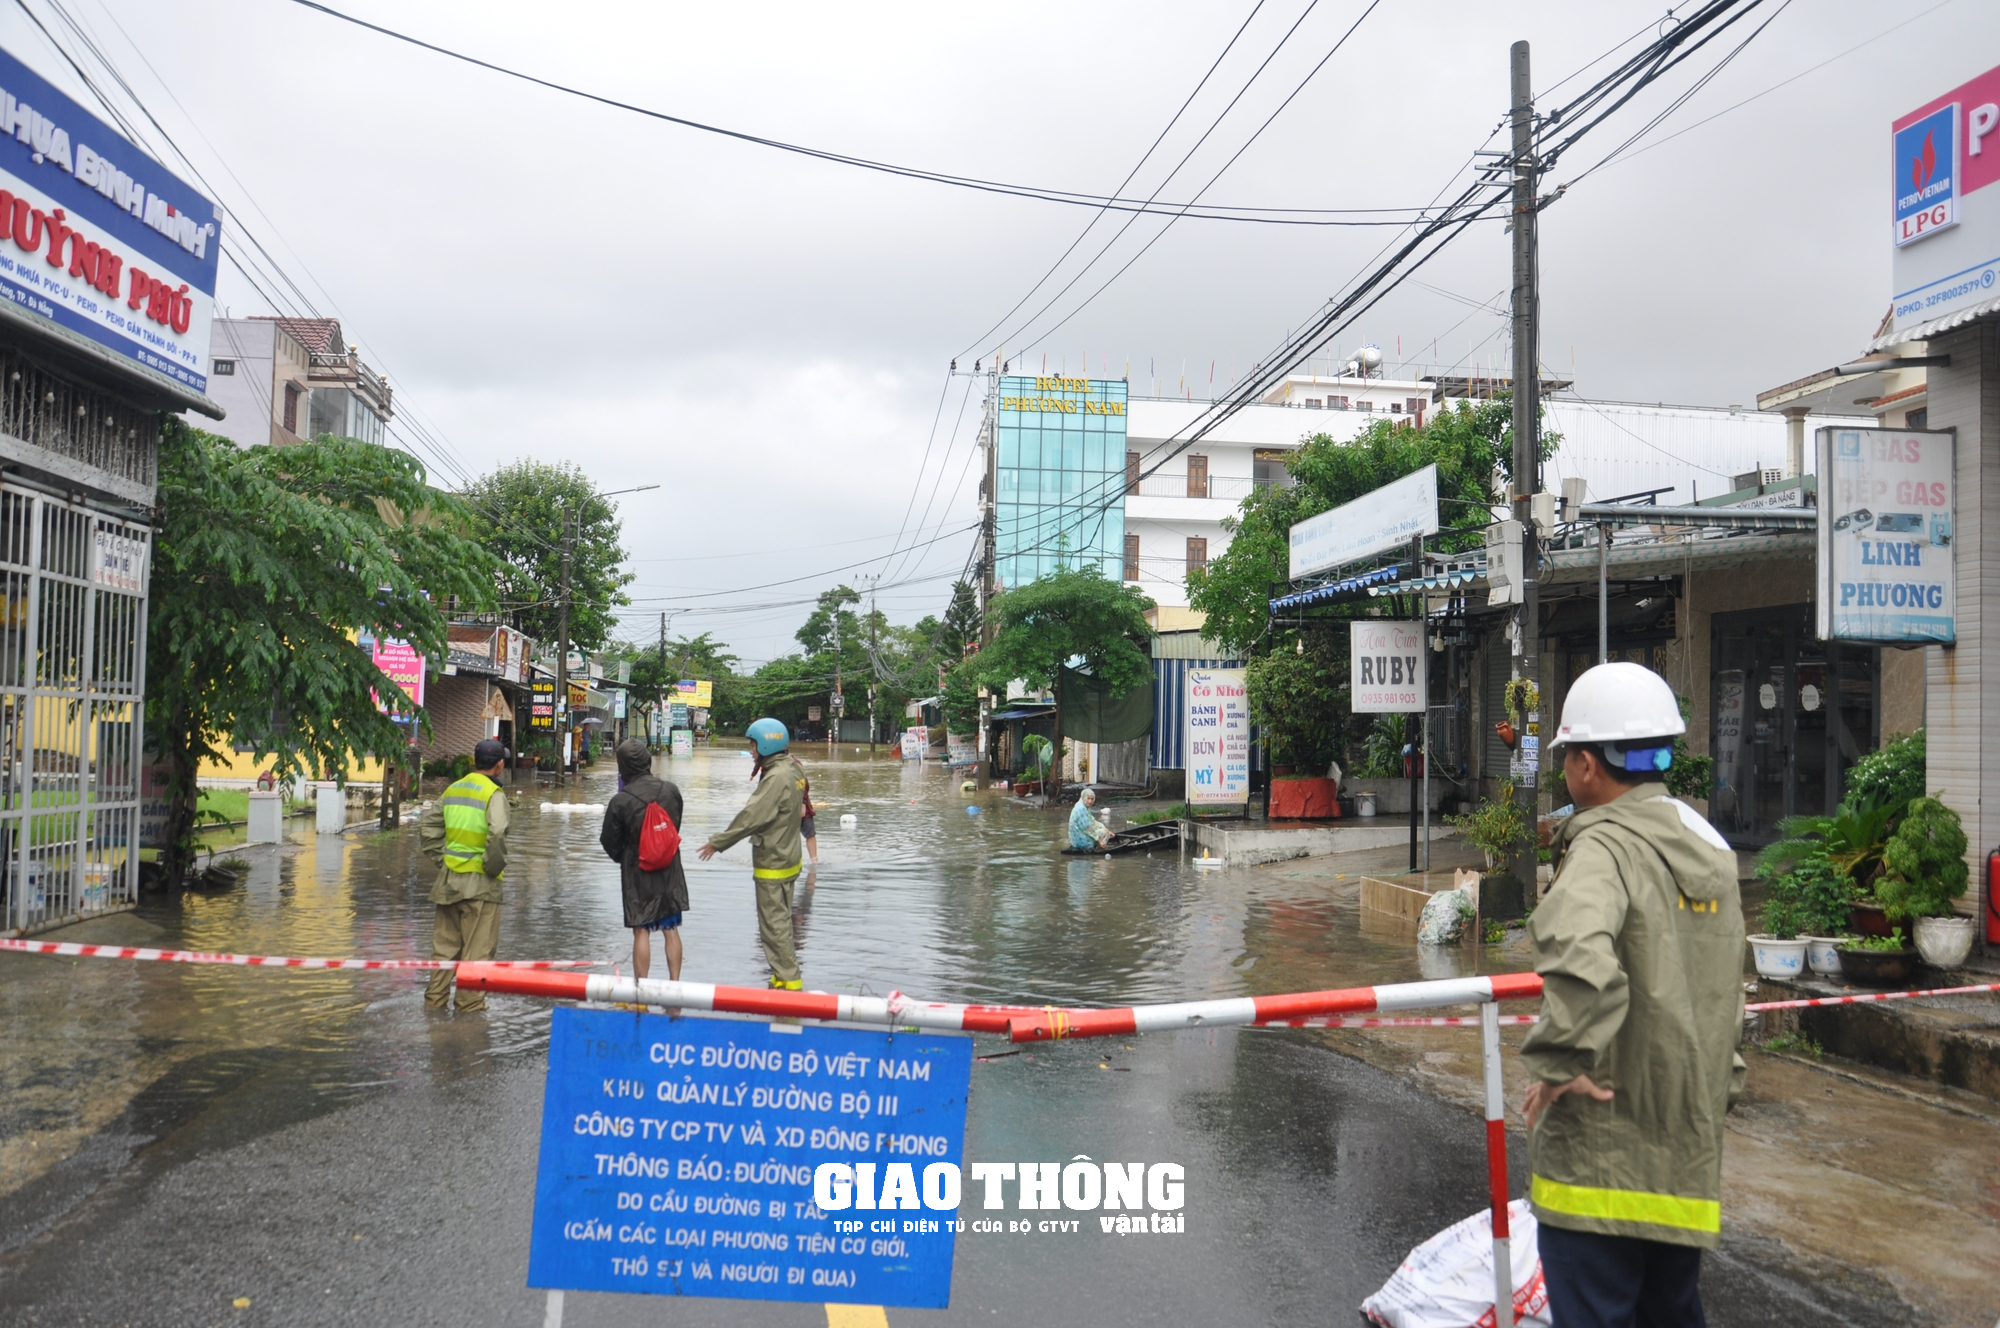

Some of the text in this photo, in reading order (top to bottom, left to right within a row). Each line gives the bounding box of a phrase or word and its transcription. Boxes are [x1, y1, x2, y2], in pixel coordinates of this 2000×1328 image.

[1898, 177, 1950, 211] PETROVIETNAM
[1902, 204, 1946, 239] LPG
[76, 295, 98, 314] PEHD
[106, 309, 125, 328] PEHD
[1896, 278, 1980, 318] GPKD: 32F8002579
[1035, 376, 1094, 393] HOTEL
[1003, 395, 1123, 415] PHƯƠNG NAM
[1871, 438, 1921, 463] GAS
[1896, 481, 1946, 506] GAS
[1862, 541, 1921, 566] LINH
[1840, 582, 1942, 609] PHƯƠNG
[1361, 656, 1417, 685] RUBY
[532, 705, 553, 715] KEM
[1191, 704, 1216, 715] BÁNH
[1361, 692, 1416, 704] 0935 981 903
[1191, 717, 1216, 727] CANH
[1192, 738, 1215, 755] BÚN
[1195, 764, 1214, 785] MỲ
[650, 1043, 696, 1069] CỤC
[788, 1049, 819, 1078] BỘ
[824, 1051, 870, 1080] VIỆT
[878, 1058, 931, 1082] NAM
[603, 1075, 899, 1119] KHU QUẢN LÝ ĐƯỜNG BỘ III
[573, 1110, 635, 1138] CÔNG
[639, 1118, 669, 1140] TY
[670, 1121, 701, 1142] CP
[704, 1122, 735, 1144] TV
[740, 1119, 766, 1146] VÀ
[774, 1126, 805, 1148] XD
[810, 1126, 870, 1152] ĐÔNG
[594, 1151, 670, 1179] THÔNG
[734, 1157, 812, 1186] ĐƯỜNG
[616, 1191, 644, 1211] DO
[694, 1192, 761, 1216] ĐƯỜNG
[768, 1200, 787, 1222] BỊ
[618, 1221, 657, 1244] CÁC
[664, 1227, 706, 1249] LOẠI
[711, 1230, 789, 1251] PHƯƠNG
[795, 1232, 837, 1256] TIỆN
[841, 1236, 868, 1256] CƠ
[610, 1254, 649, 1277] THÔ
[691, 1257, 714, 1281] VÀ
[786, 1266, 805, 1285] ĐI
[811, 1268, 857, 1288] QUA)
